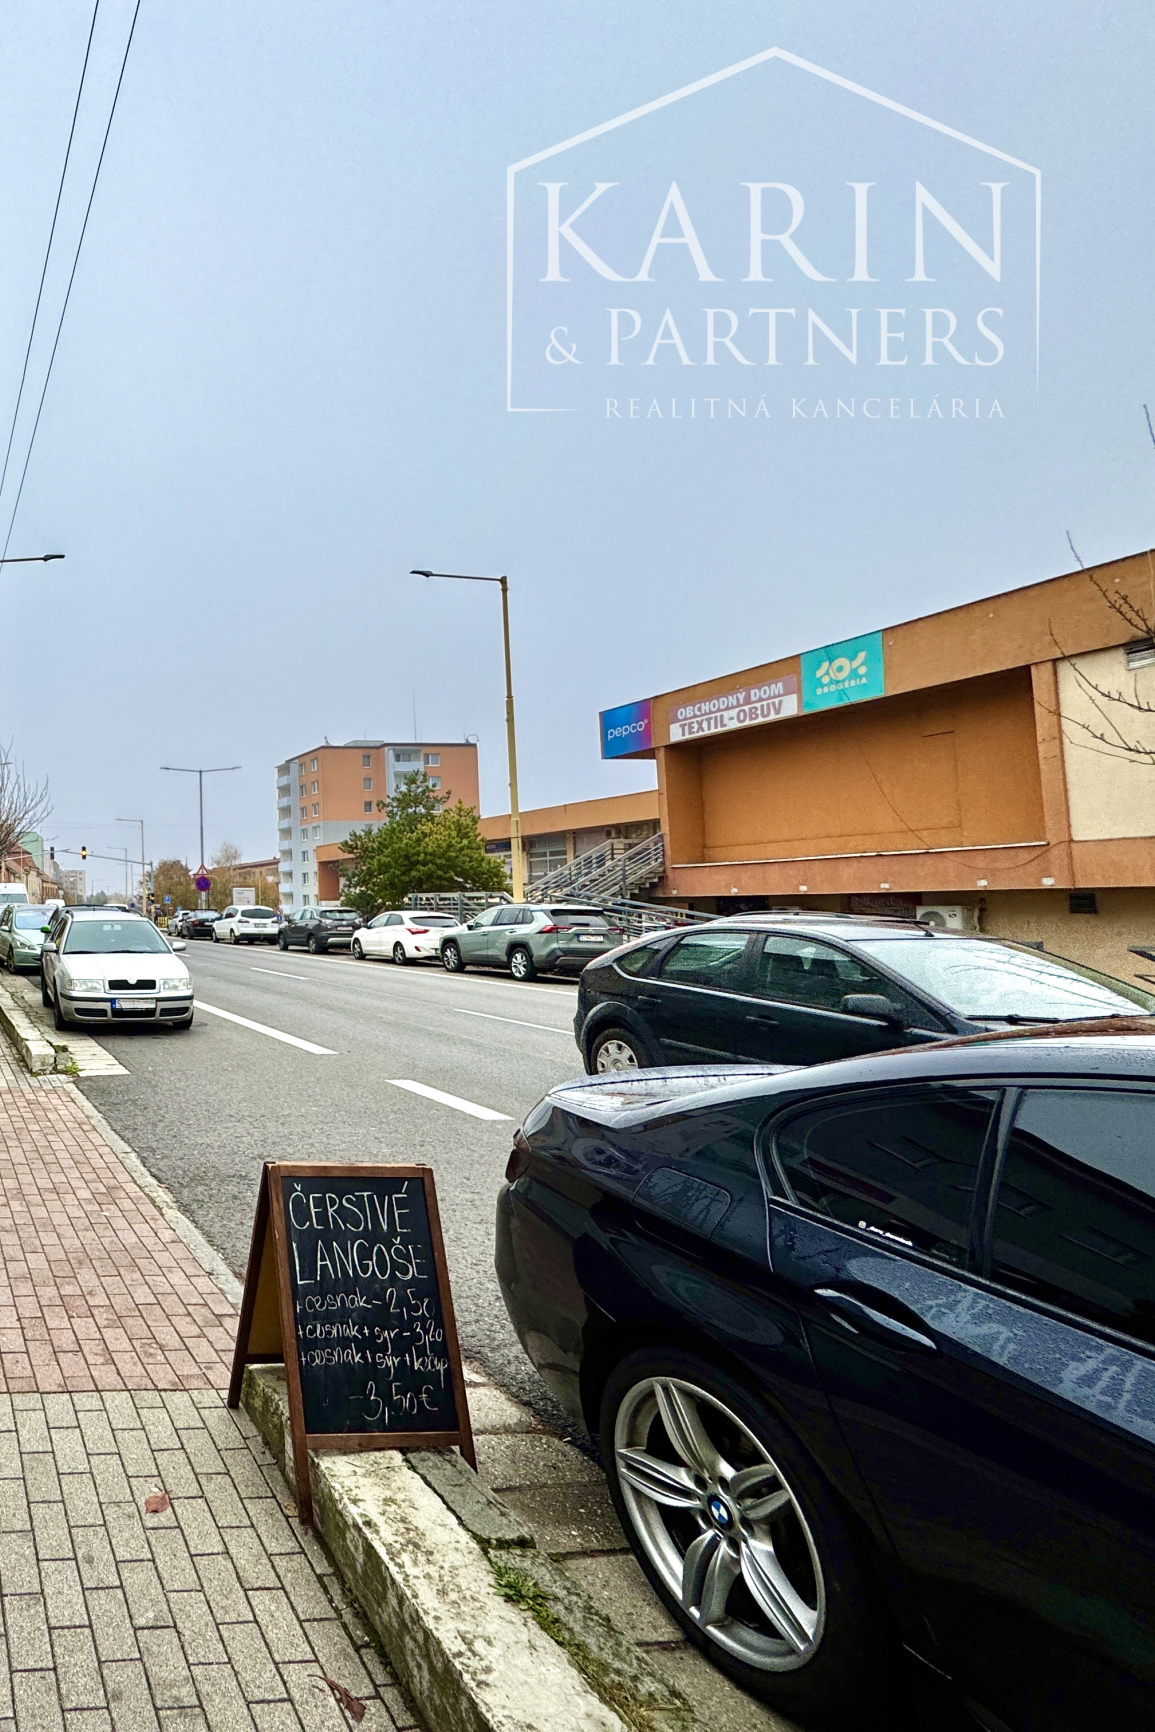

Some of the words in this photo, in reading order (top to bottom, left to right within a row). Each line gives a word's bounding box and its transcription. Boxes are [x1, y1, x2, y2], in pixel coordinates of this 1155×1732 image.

[677, 688, 746, 719] OBCHODNÝ
[750, 682, 784, 701] DOM
[607, 721, 645, 741] pepco
[289, 1180, 411, 1233] ČERSTVÉ
[292, 1236, 429, 1285] LANGOŠE
